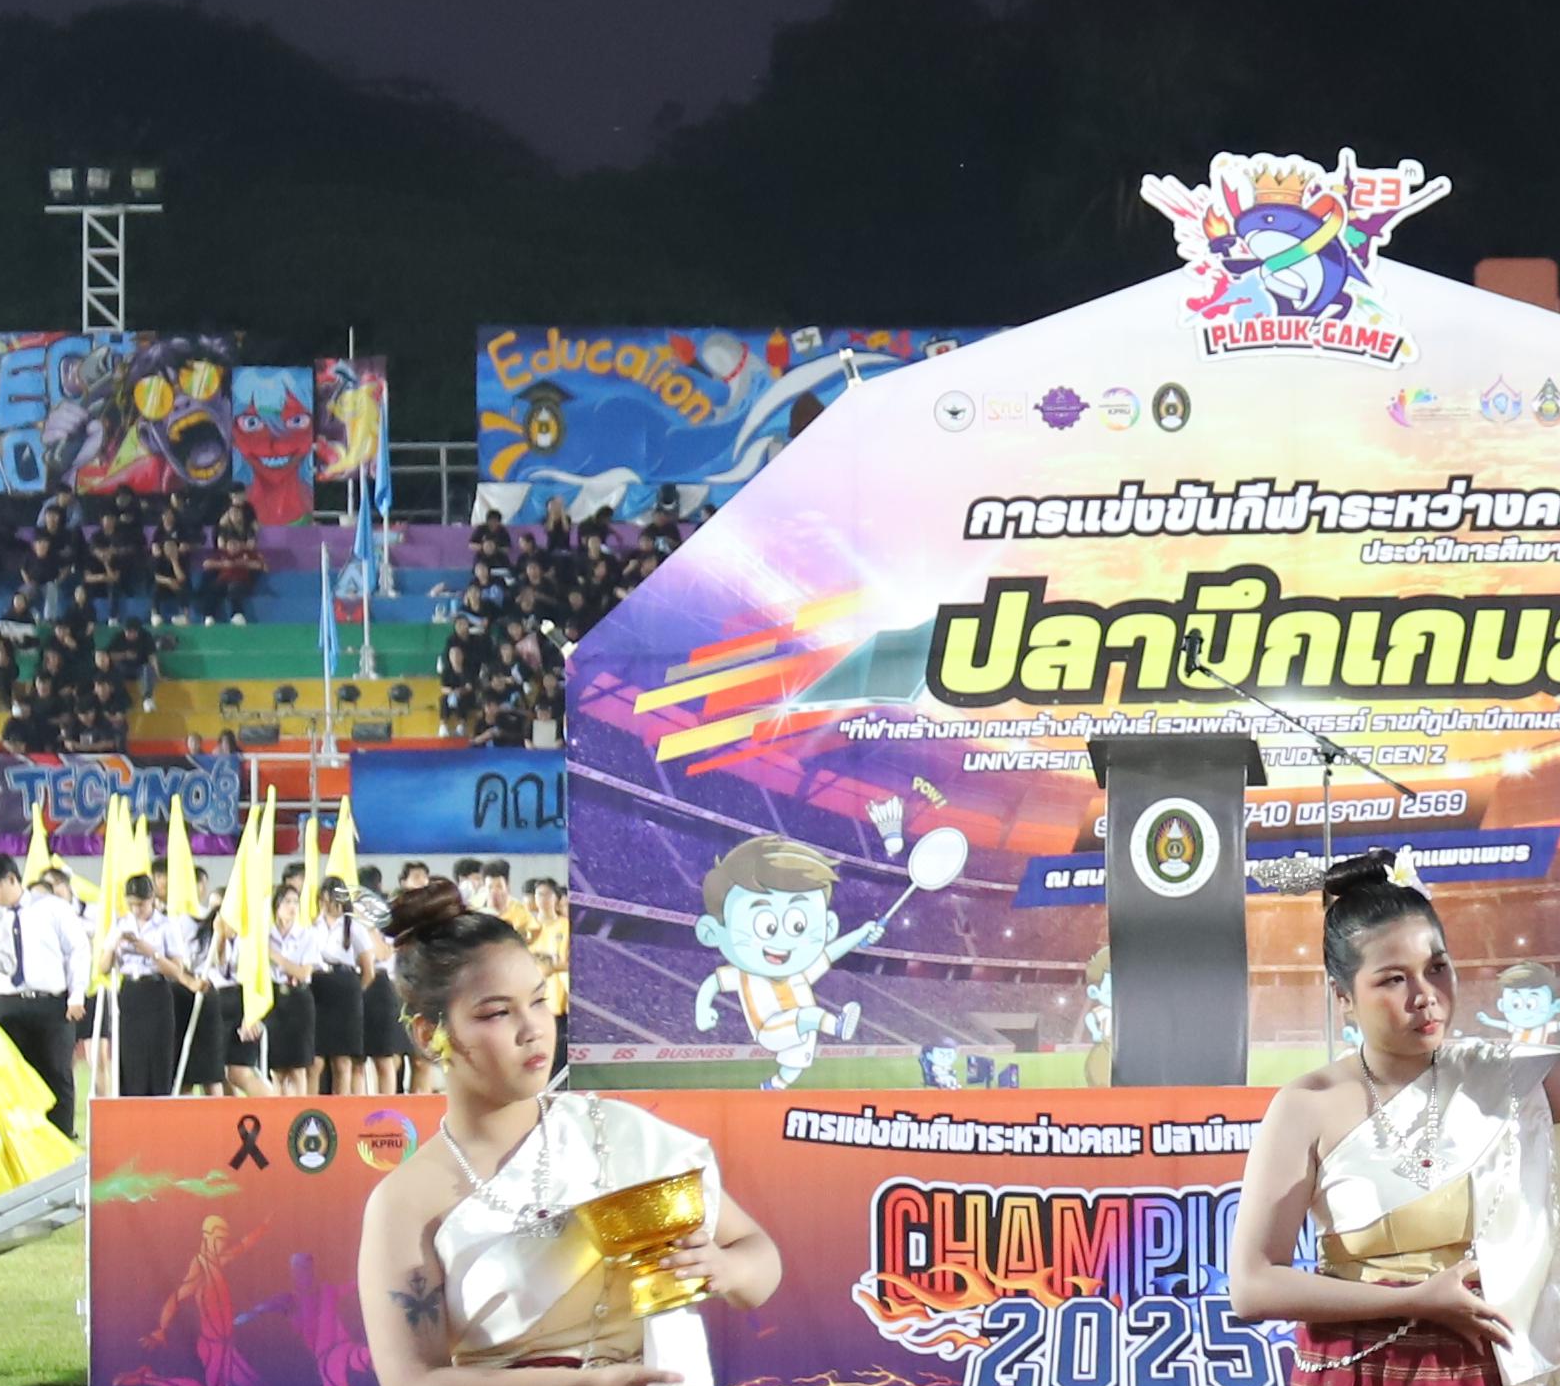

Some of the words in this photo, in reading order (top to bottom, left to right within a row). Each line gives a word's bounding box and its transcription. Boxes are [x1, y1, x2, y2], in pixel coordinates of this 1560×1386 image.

[1354, 176, 1401, 206] 23
[1211, 319, 1311, 348] PLABUK
[1322, 321, 1396, 355] GAME
[487, 327, 712, 426] Education
[1376, 746, 1425, 765] GEN
[1427, 745, 1447, 764] Z
[474, 771, 566, 829] คณ
[910, 776, 949, 810] POW!
[1298, 796, 1393, 824] มกราคม
[1400, 790, 1466, 819] 2569
[655, 1046, 735, 1060] BUSINESS
[371, 1138, 404, 1149] KPRU
[785, 1108, 1141, 1155] การแข่งขันกีฬาระหว่างคณะ
